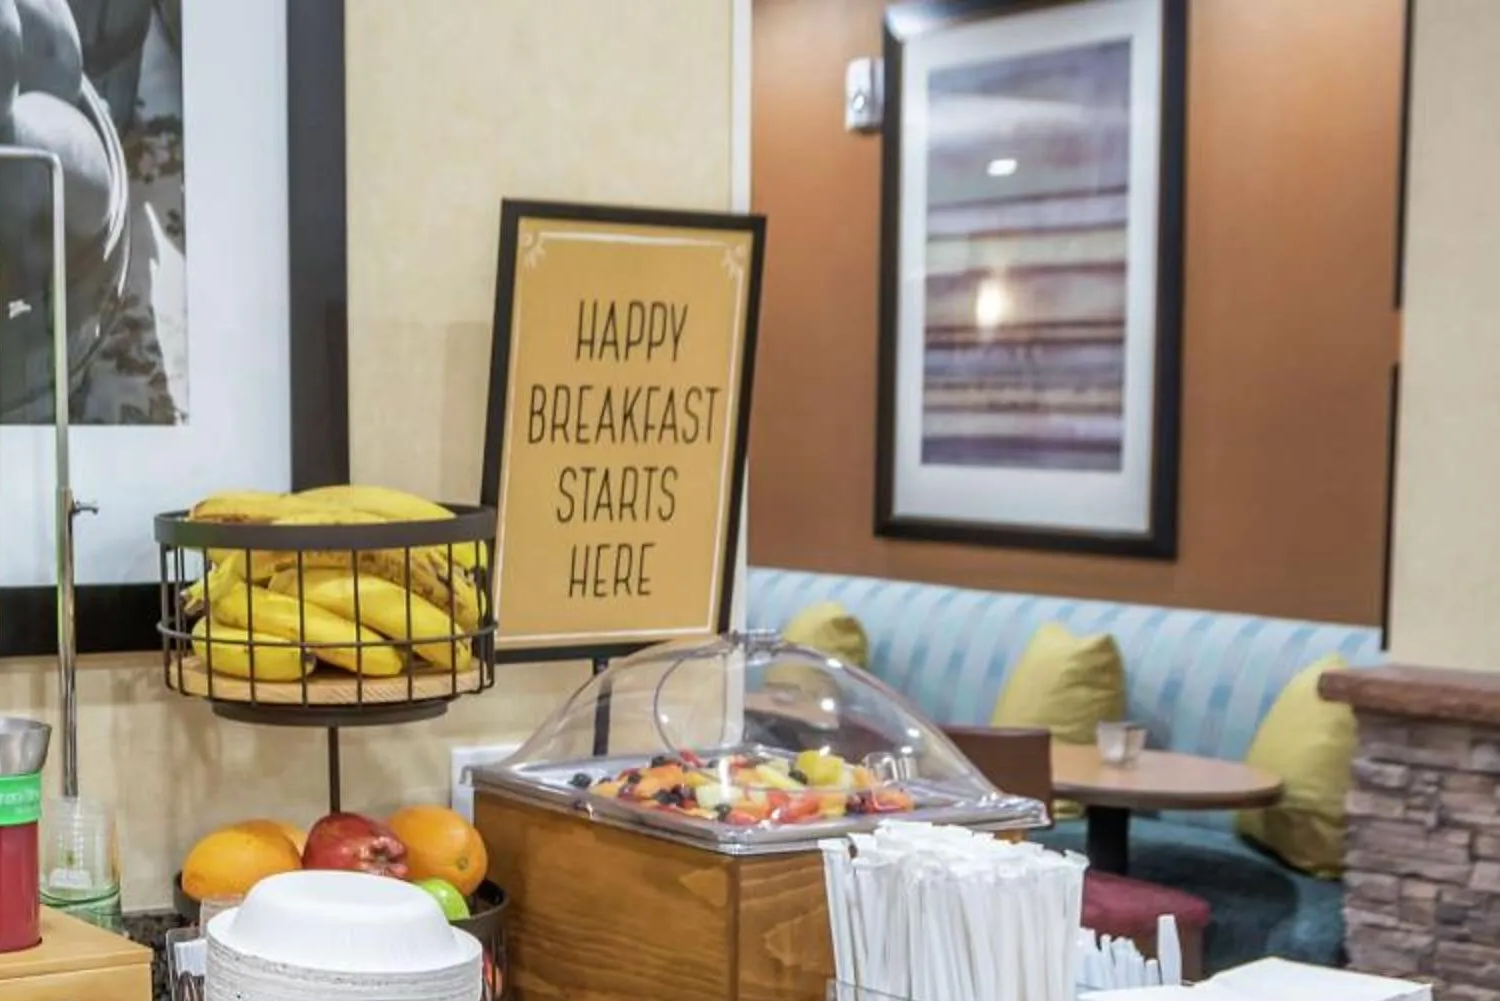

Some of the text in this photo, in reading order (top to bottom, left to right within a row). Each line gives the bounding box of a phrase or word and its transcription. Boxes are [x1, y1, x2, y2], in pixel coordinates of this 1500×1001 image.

[575, 300, 688, 362] HAPPY
[528, 384, 721, 445] BREAKFAST
[557, 466, 679, 523] STARTS
[568, 543, 656, 598] HERE
